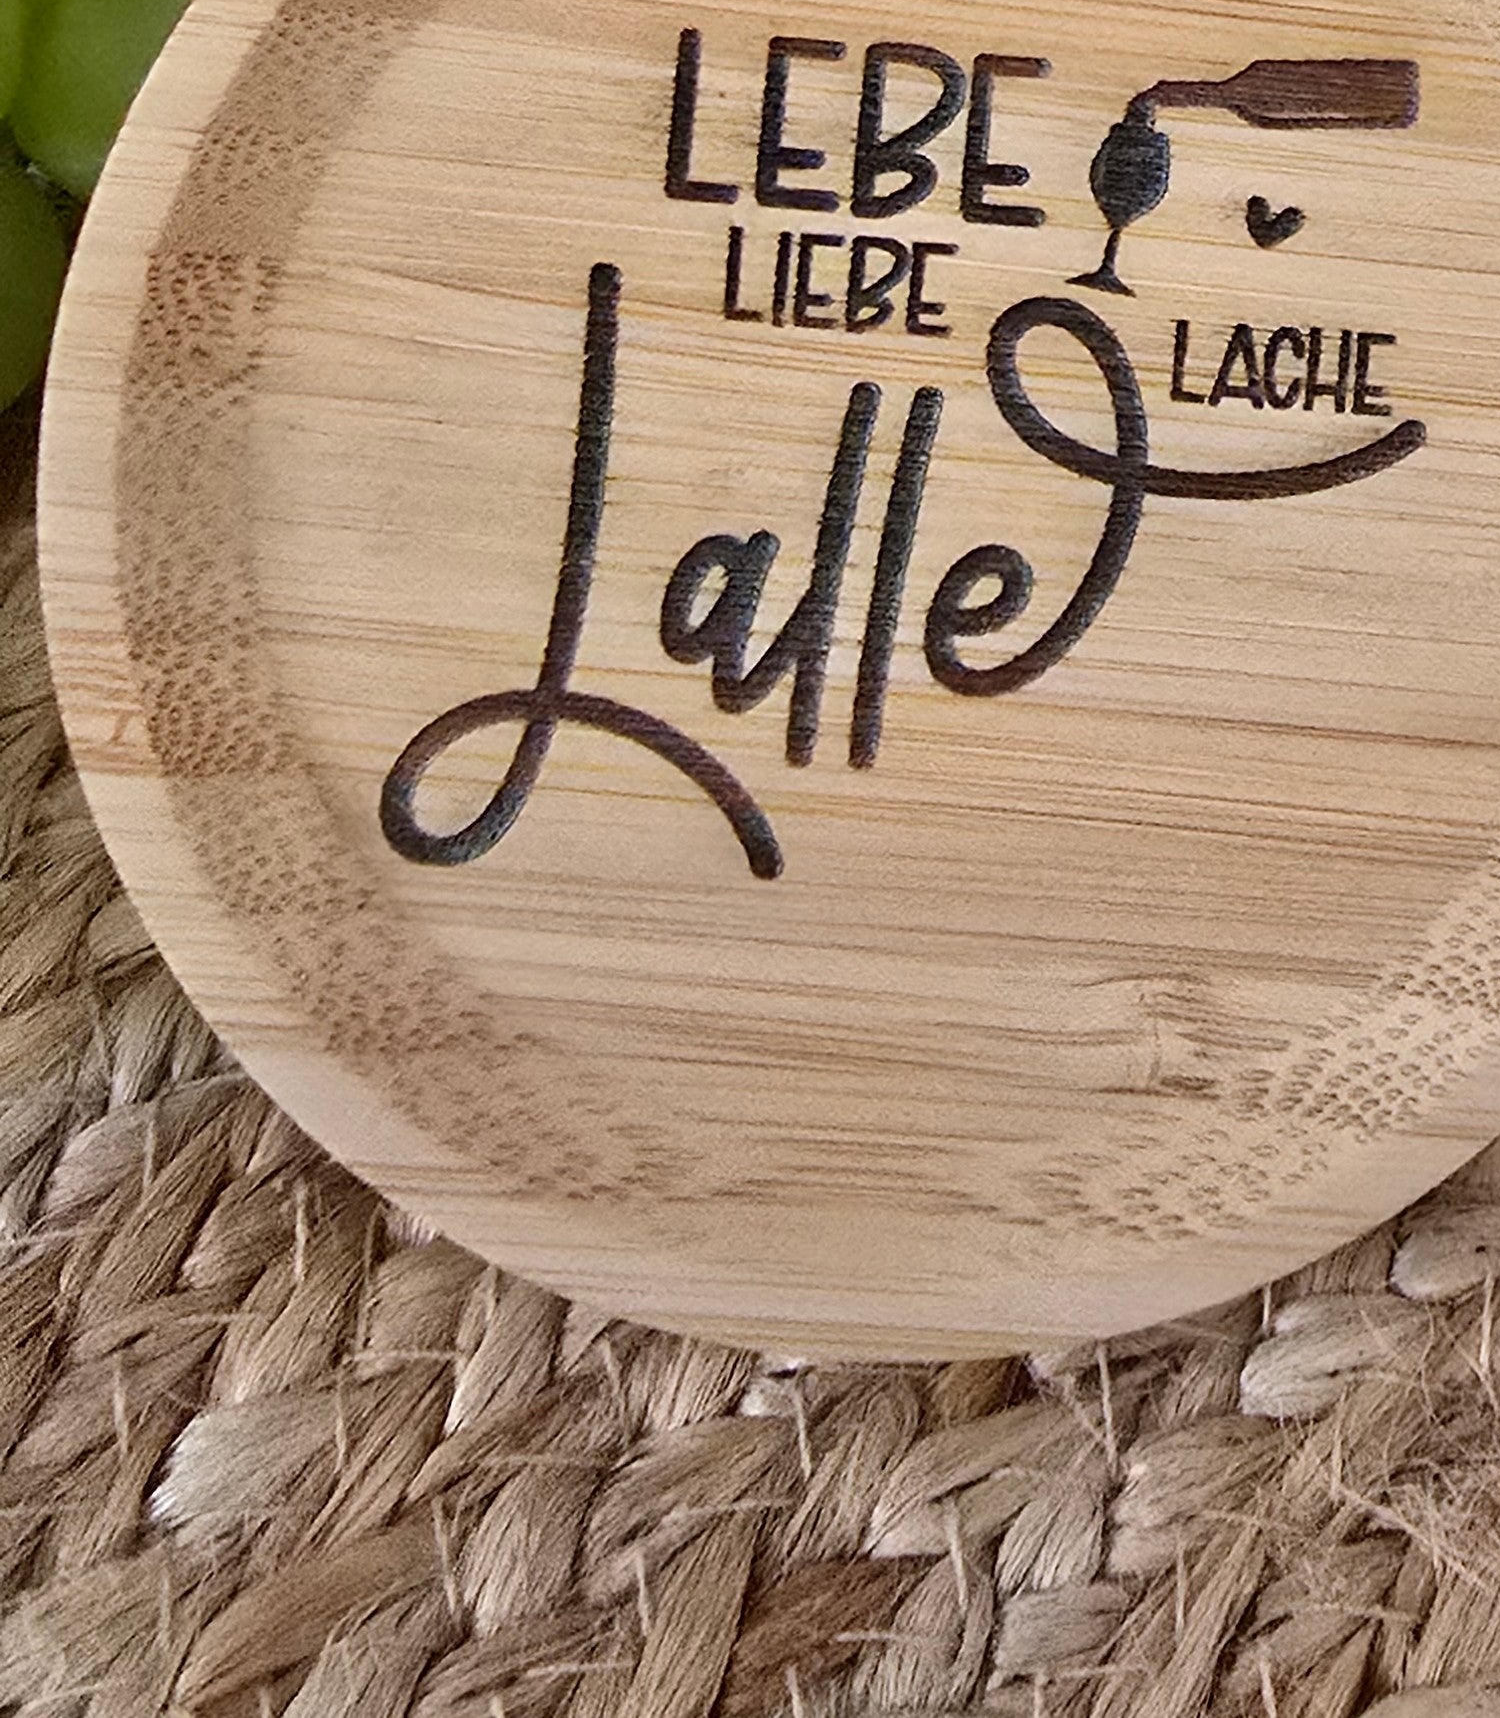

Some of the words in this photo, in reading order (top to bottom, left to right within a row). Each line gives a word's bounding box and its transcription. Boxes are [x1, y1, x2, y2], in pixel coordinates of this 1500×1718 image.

[664, 27, 1052, 227] LEBE
[723, 225, 959, 339] LIEBE
[1170, 318, 1397, 417] LACHE
[379, 262, 1427, 880] Lalle
